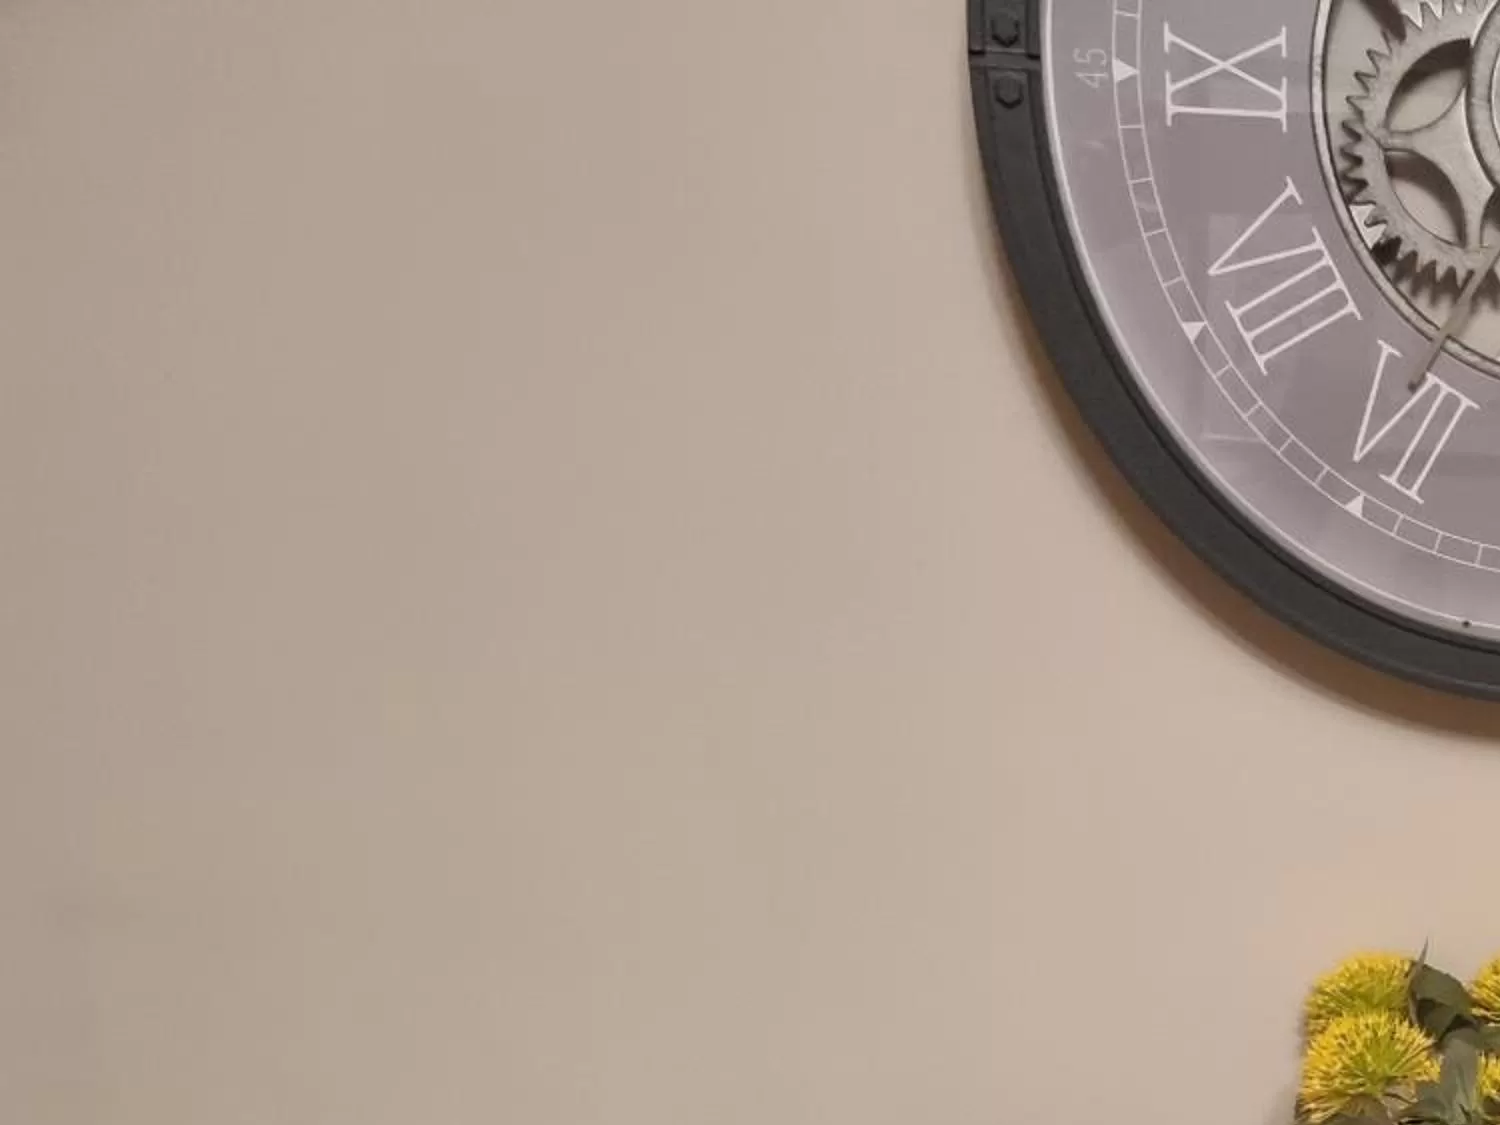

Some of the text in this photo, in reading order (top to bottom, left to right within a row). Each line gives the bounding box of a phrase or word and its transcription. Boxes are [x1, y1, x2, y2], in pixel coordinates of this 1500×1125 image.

[1073, 47, 1109, 88] 45
[1207, 175, 1362, 375] VIII
[1352, 339, 1480, 504] VII
